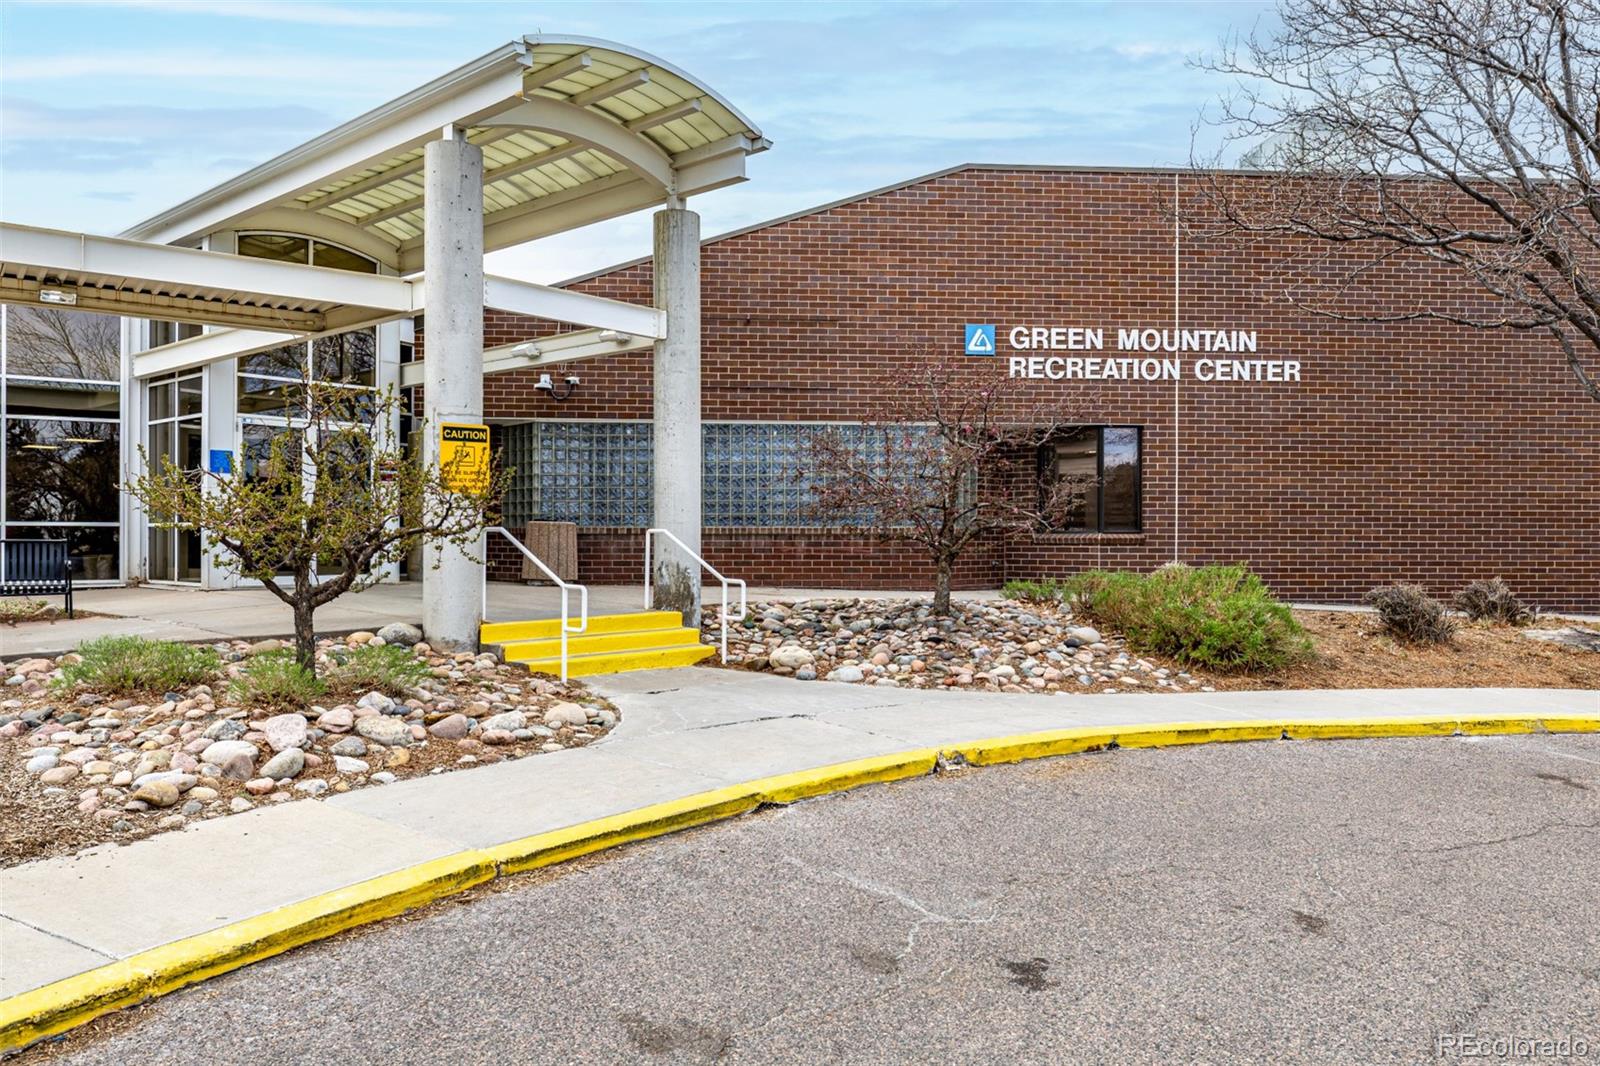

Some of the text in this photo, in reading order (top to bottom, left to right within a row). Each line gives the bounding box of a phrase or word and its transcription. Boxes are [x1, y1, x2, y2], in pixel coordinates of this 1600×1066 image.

[1009, 327, 1258, 353] GREEN MOUNTAIN
[1008, 357, 1302, 382] RECREATION CENTER
[444, 429, 486, 440] CAUTION
